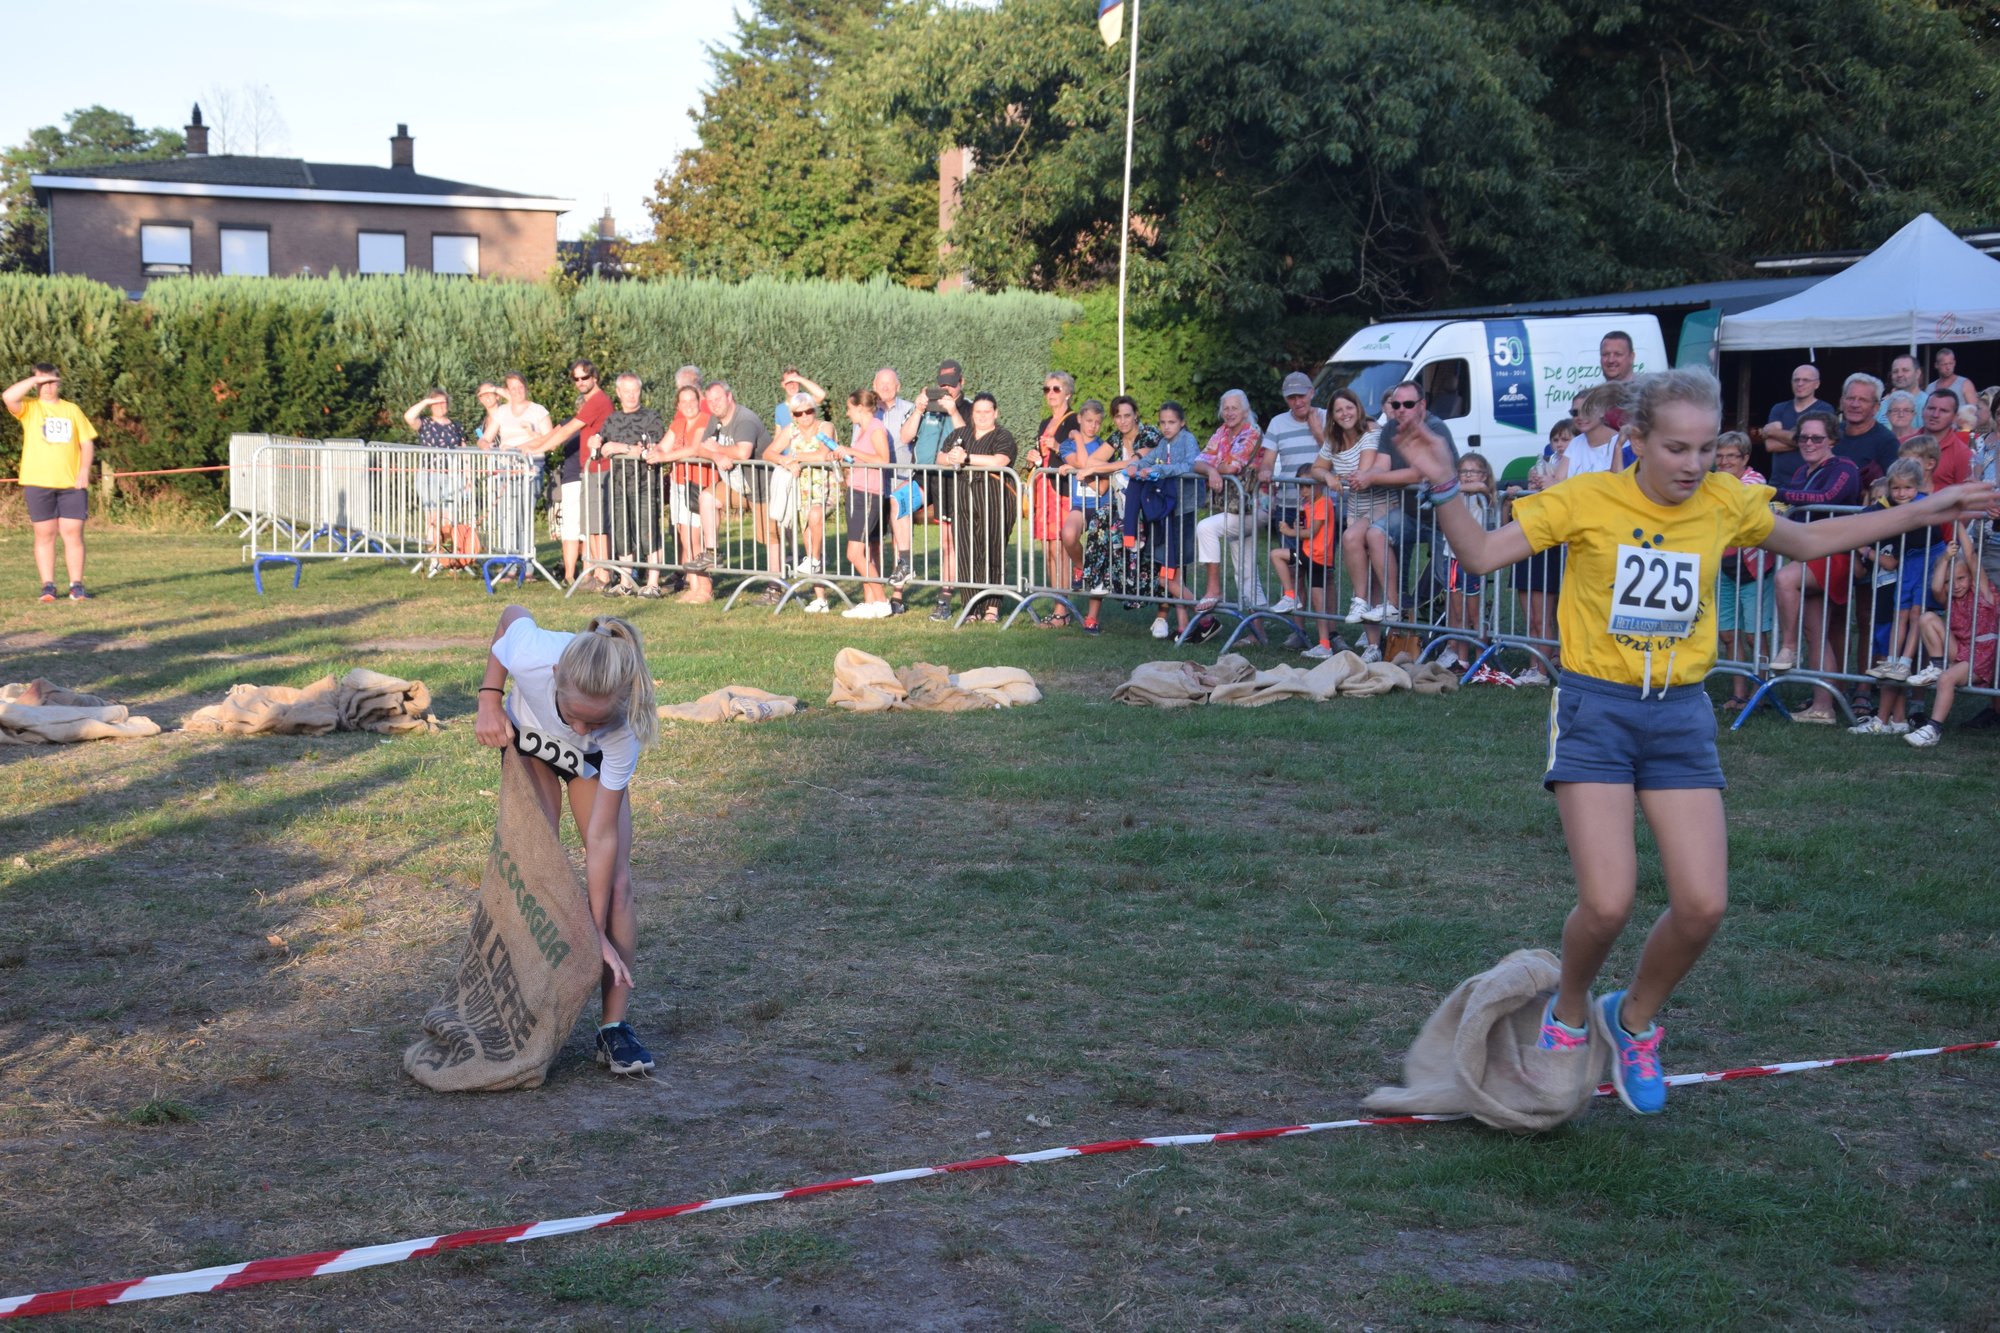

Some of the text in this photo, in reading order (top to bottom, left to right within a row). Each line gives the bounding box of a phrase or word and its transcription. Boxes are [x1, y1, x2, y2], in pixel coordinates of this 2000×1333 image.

[1954, 326, 1984, 335] essen
[1494, 336, 1524, 366] 50
[1544, 366, 1562, 380] De
[48, 420, 68, 434] 391
[1619, 554, 1693, 612] 225
[526, 732, 579, 777] 223
